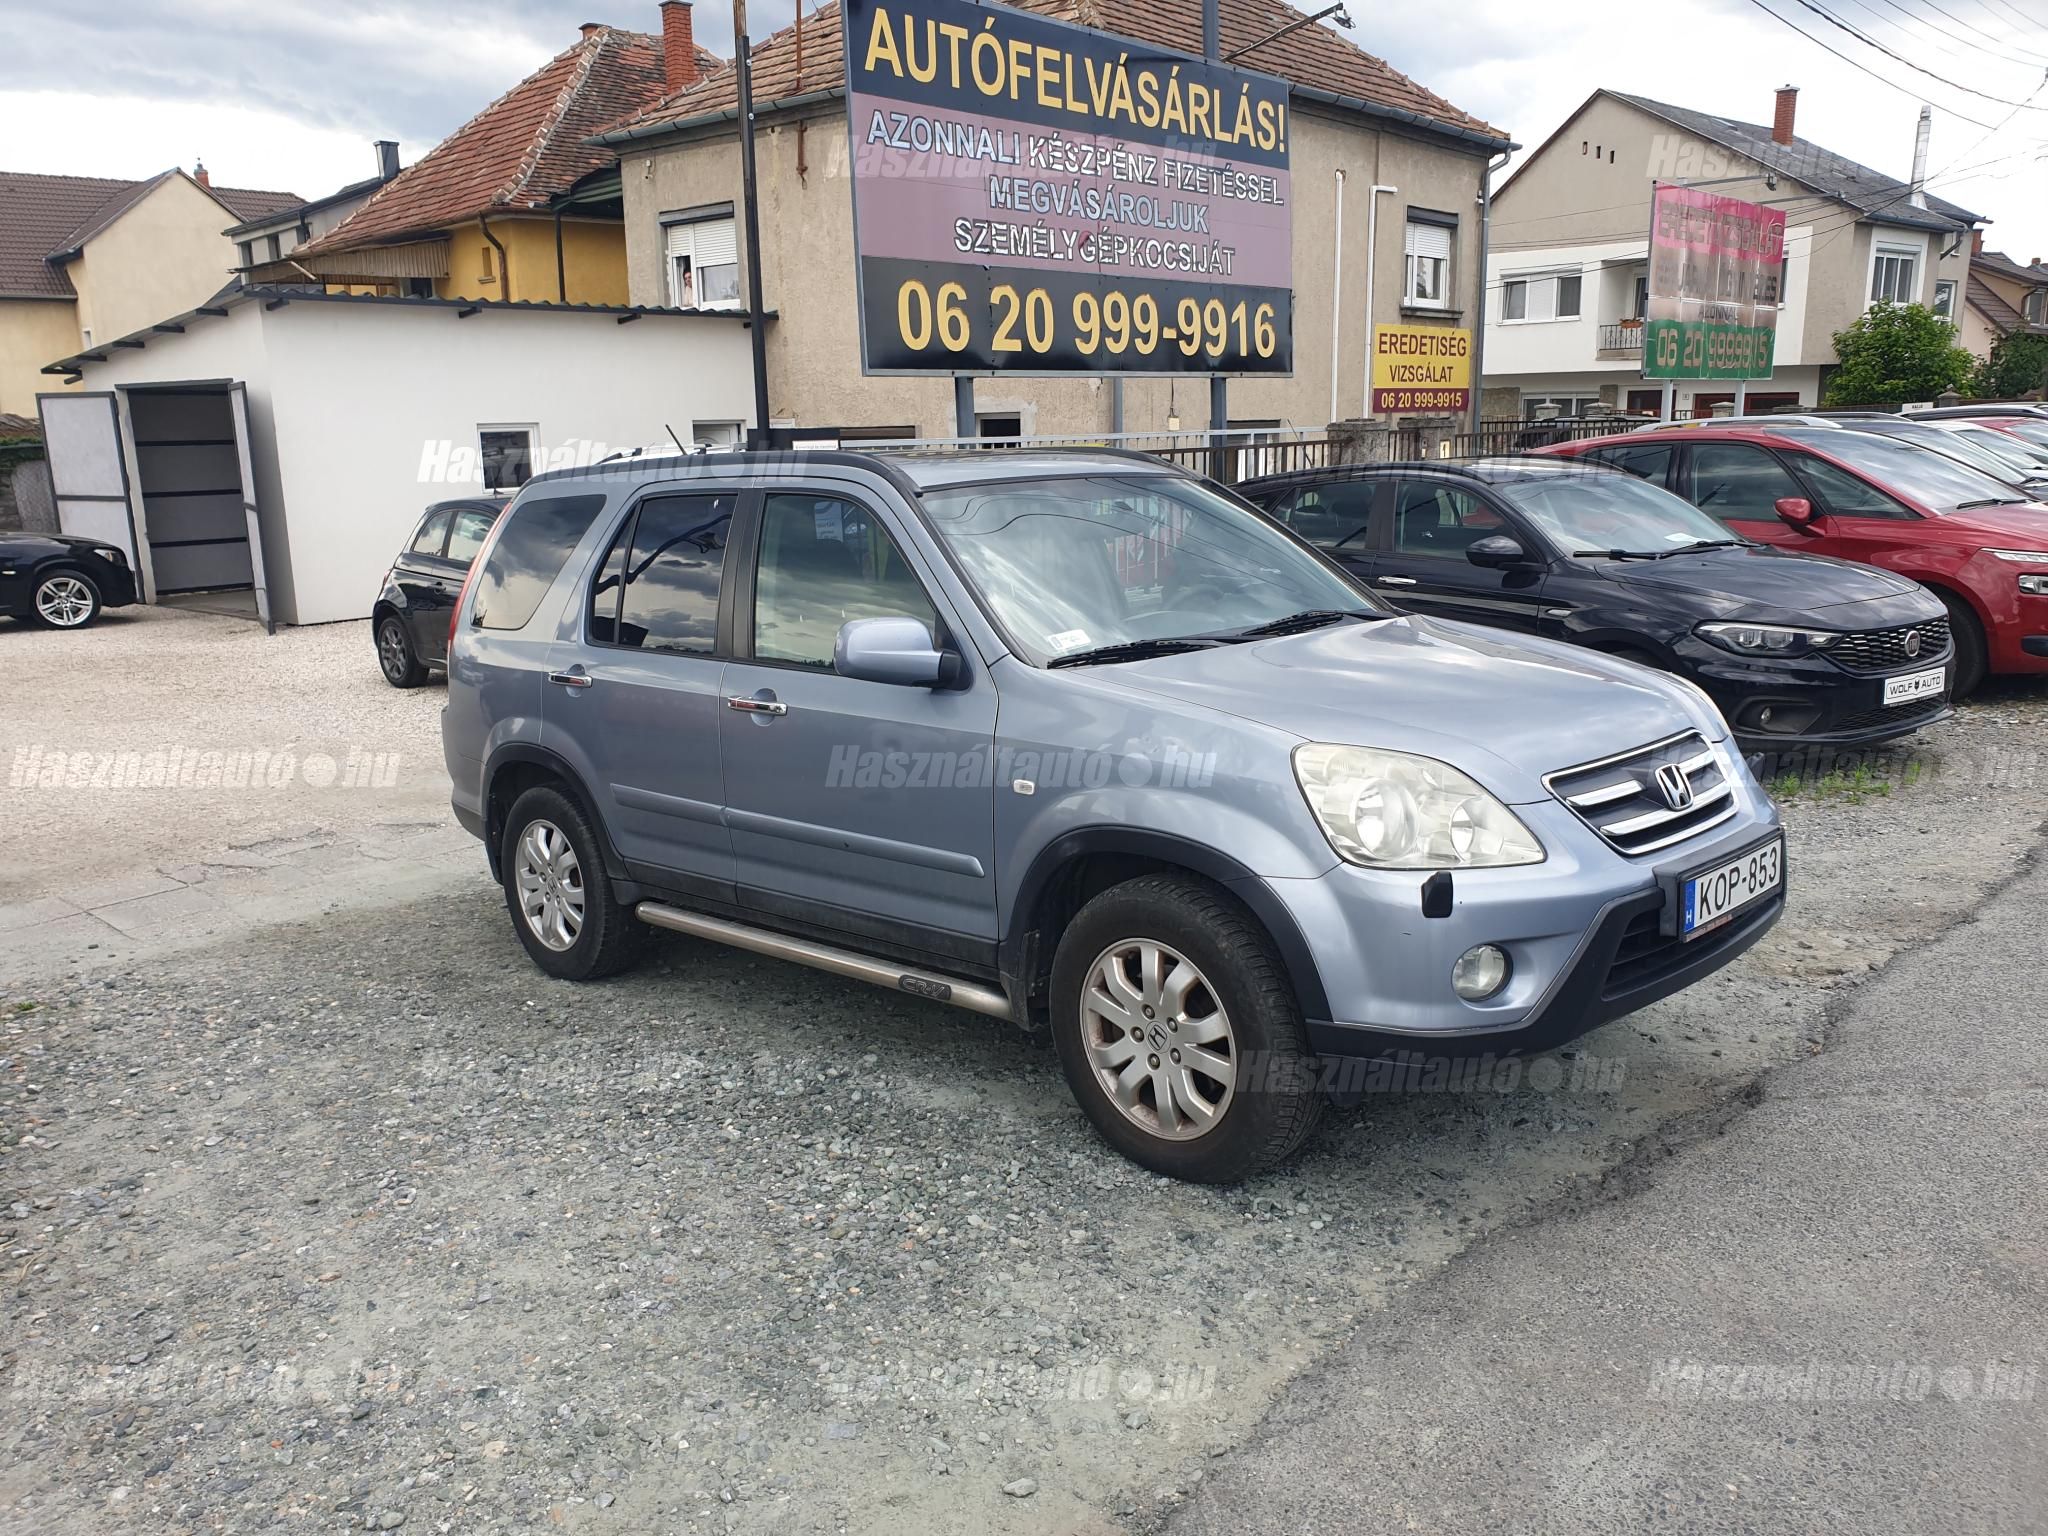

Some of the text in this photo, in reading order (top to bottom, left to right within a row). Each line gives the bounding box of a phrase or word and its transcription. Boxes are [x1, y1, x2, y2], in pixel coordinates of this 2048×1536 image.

[865, 7, 1284, 153] AUTÓFELVÁSÁRLÁS!
[866, 108, 1286, 206] AZONNALI KÉSZPÉNZ FIZETÉSSEL
[989, 174, 1210, 234] MEGVÁSÁROLJUK
[898, 278, 1276, 358] 06 20 999-9916
[1378, 331, 1467, 357] EREDETISÉG
[1656, 328, 1678, 368] 06
[1682, 330, 1704, 368] 20
[1389, 361, 1454, 383] VIZSGÁLAT
[1381, 391, 1462, 408] 06 20 999-9915
[1889, 675, 1941, 696] WOLF AUTO
[1699, 846, 1777, 920] KOP-853
[1685, 908, 1693, 925] H
